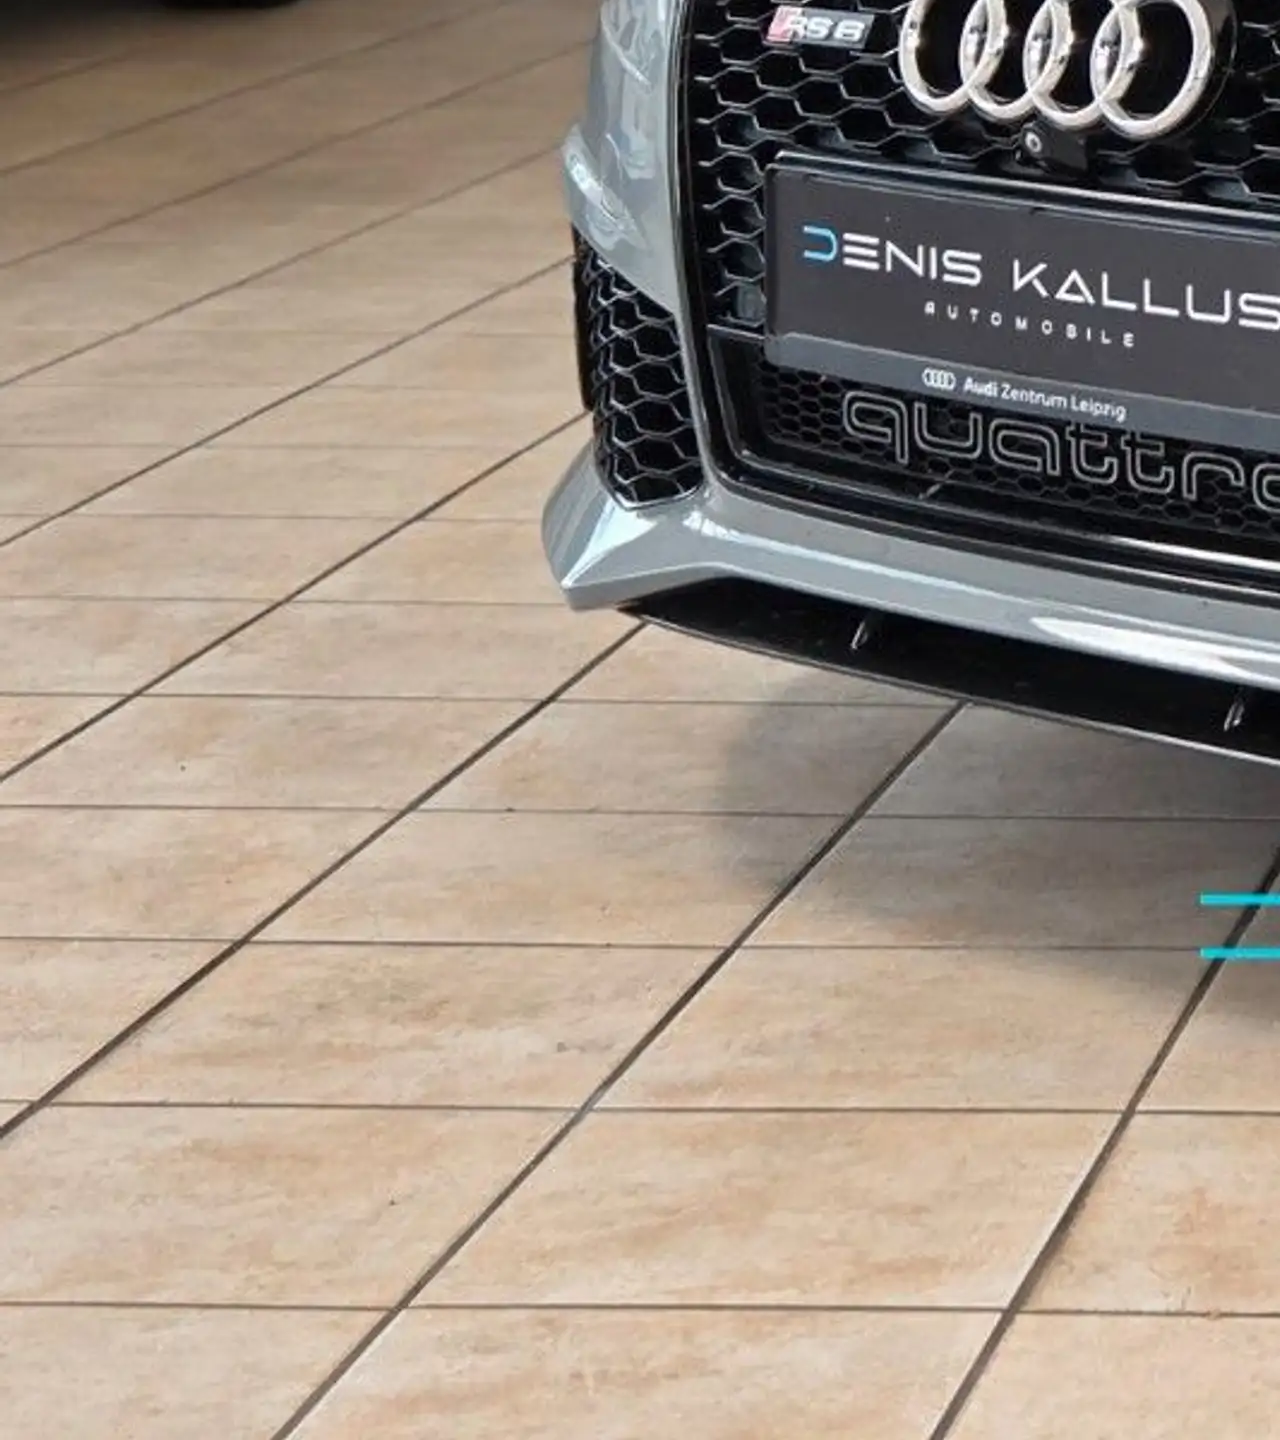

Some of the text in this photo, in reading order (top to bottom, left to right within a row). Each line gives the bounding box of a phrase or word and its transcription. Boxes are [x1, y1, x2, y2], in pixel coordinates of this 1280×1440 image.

[803, 225, 983, 287] DENIS
[924, 301, 1135, 348] AUTOMOBILE
[963, 376, 1128, 424] Audi Zentrum Leipzig
